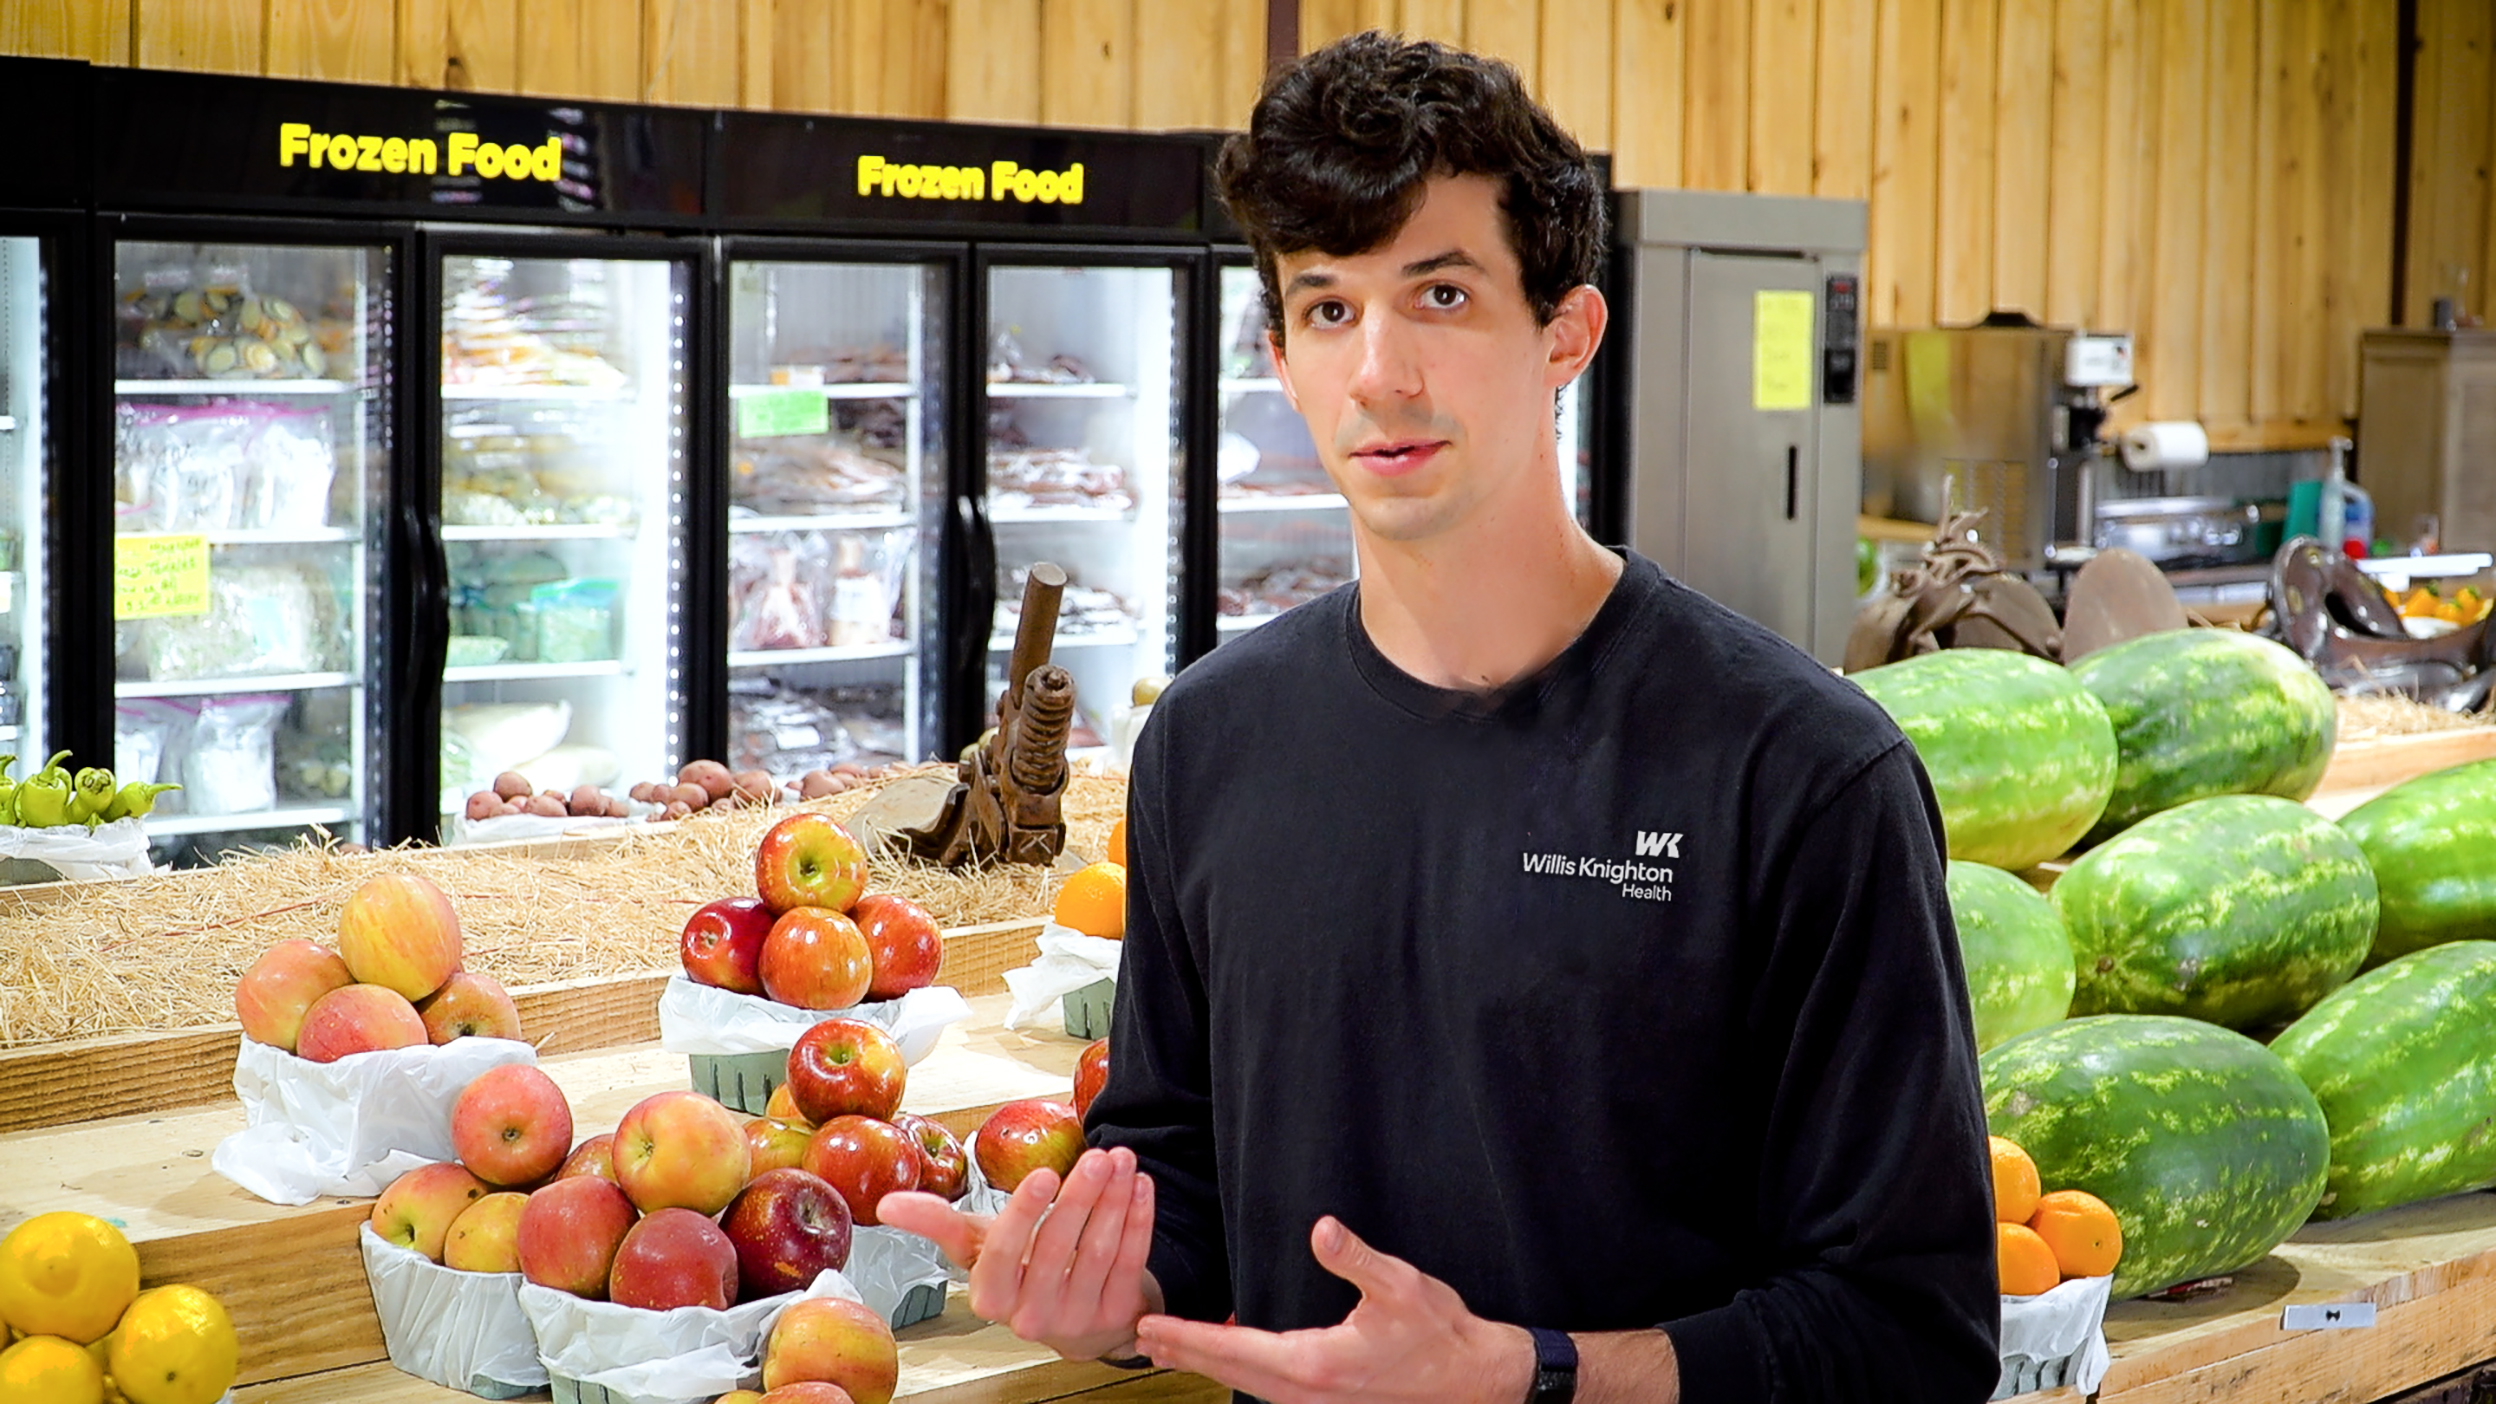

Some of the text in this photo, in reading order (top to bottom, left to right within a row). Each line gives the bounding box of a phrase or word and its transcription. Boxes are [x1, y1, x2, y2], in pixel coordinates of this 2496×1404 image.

[280, 122, 564, 182] Frozen Food
[857, 154, 1085, 204] Frozen Food
[1635, 830, 1684, 859] WK
[1522, 852, 1674, 885] Willis Knighton
[1621, 883, 1673, 902] Health
